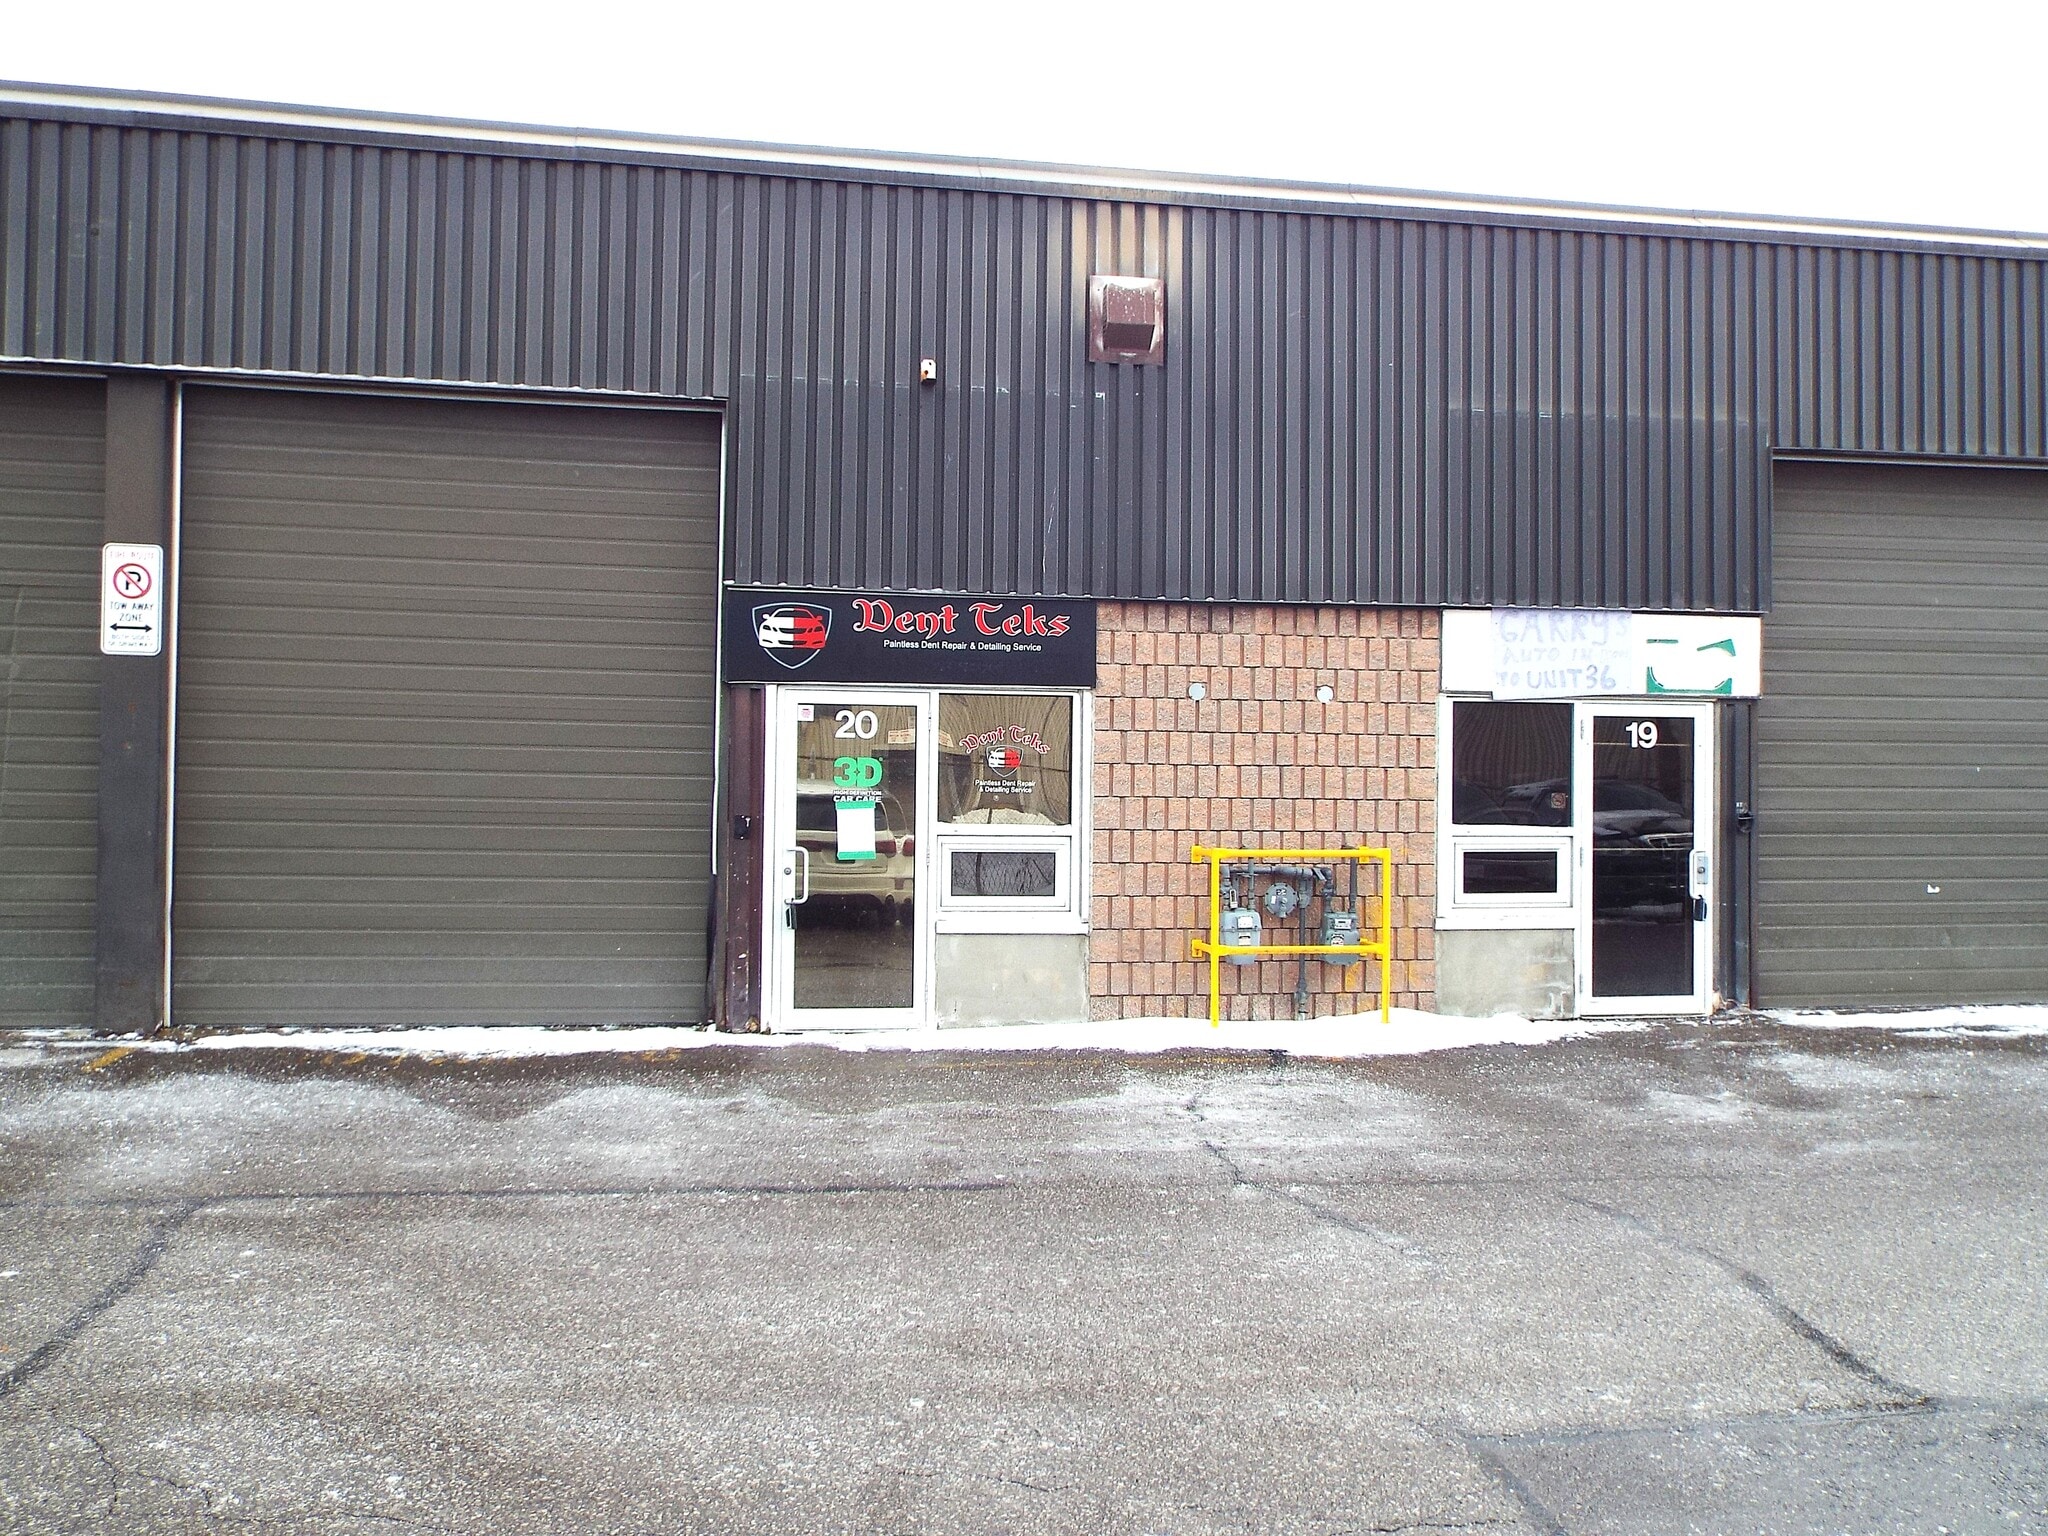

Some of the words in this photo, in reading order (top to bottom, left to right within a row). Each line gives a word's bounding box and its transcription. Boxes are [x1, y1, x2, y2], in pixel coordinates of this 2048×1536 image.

[110, 601, 127, 610] TOW
[131, 602, 154, 611] AWAY
[119, 612, 143, 623] ZONE
[852, 598, 959, 639] Dent
[969, 602, 1070, 636] Teks
[883, 639, 919, 649] Paintless
[921, 640, 940, 649] Dent
[941, 641, 967, 651] Repair
[969, 642, 976, 650] &
[977, 642, 1011, 652] Detailing
[1012, 643, 1042, 652] Service
[835, 709, 879, 739] 20
[959, 726, 1006, 754] Dent
[1008, 724, 1051, 755] Teks
[1625, 721, 1658, 748] 19
[984, 786, 1010, 794] Detailing
[1016, 780, 1036, 788] Repair
[833, 795, 853, 803] CAR
[855, 795, 882, 803] CARE
